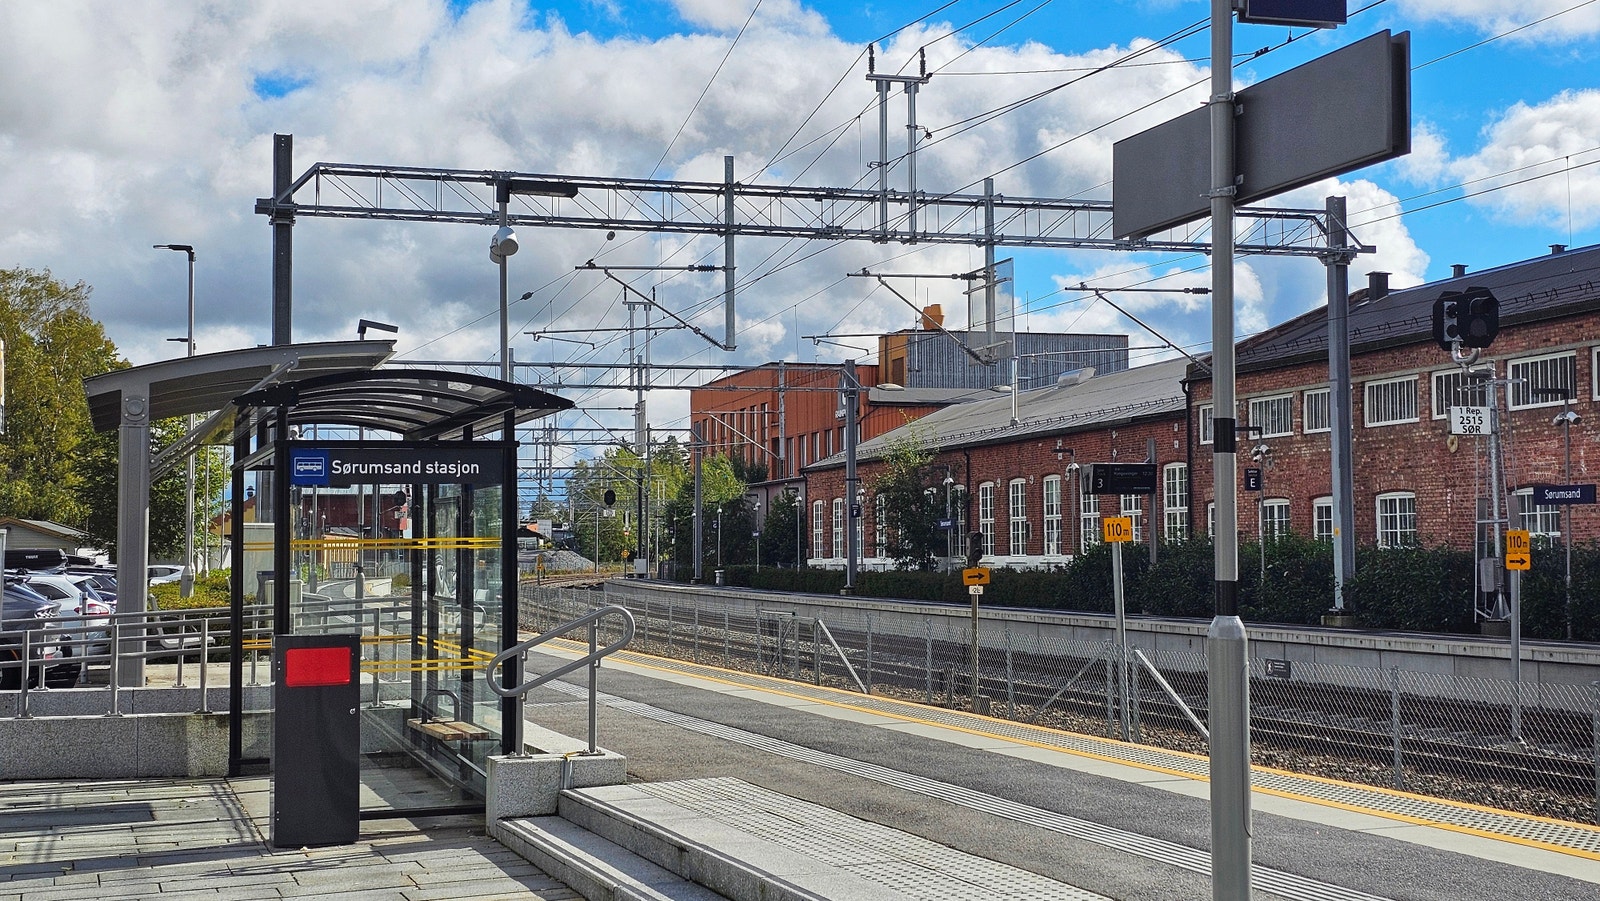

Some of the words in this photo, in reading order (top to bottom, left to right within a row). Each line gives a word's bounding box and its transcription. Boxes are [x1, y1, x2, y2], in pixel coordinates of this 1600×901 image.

[1466, 407, 1483, 416] Rep.
[1459, 416, 1484, 425] 2515
[1462, 425, 1481, 434] SØR
[331, 460, 421, 475] Sørumsand
[425, 460, 480, 478] stasjon
[1097, 478, 1104, 489] 3
[1250, 477, 1256, 488] E
[1544, 487, 1581, 500] Sørumsand
[1106, 522, 1123, 537] 110
[1123, 528, 1130, 536] m
[1508, 535, 1522, 548] 110
